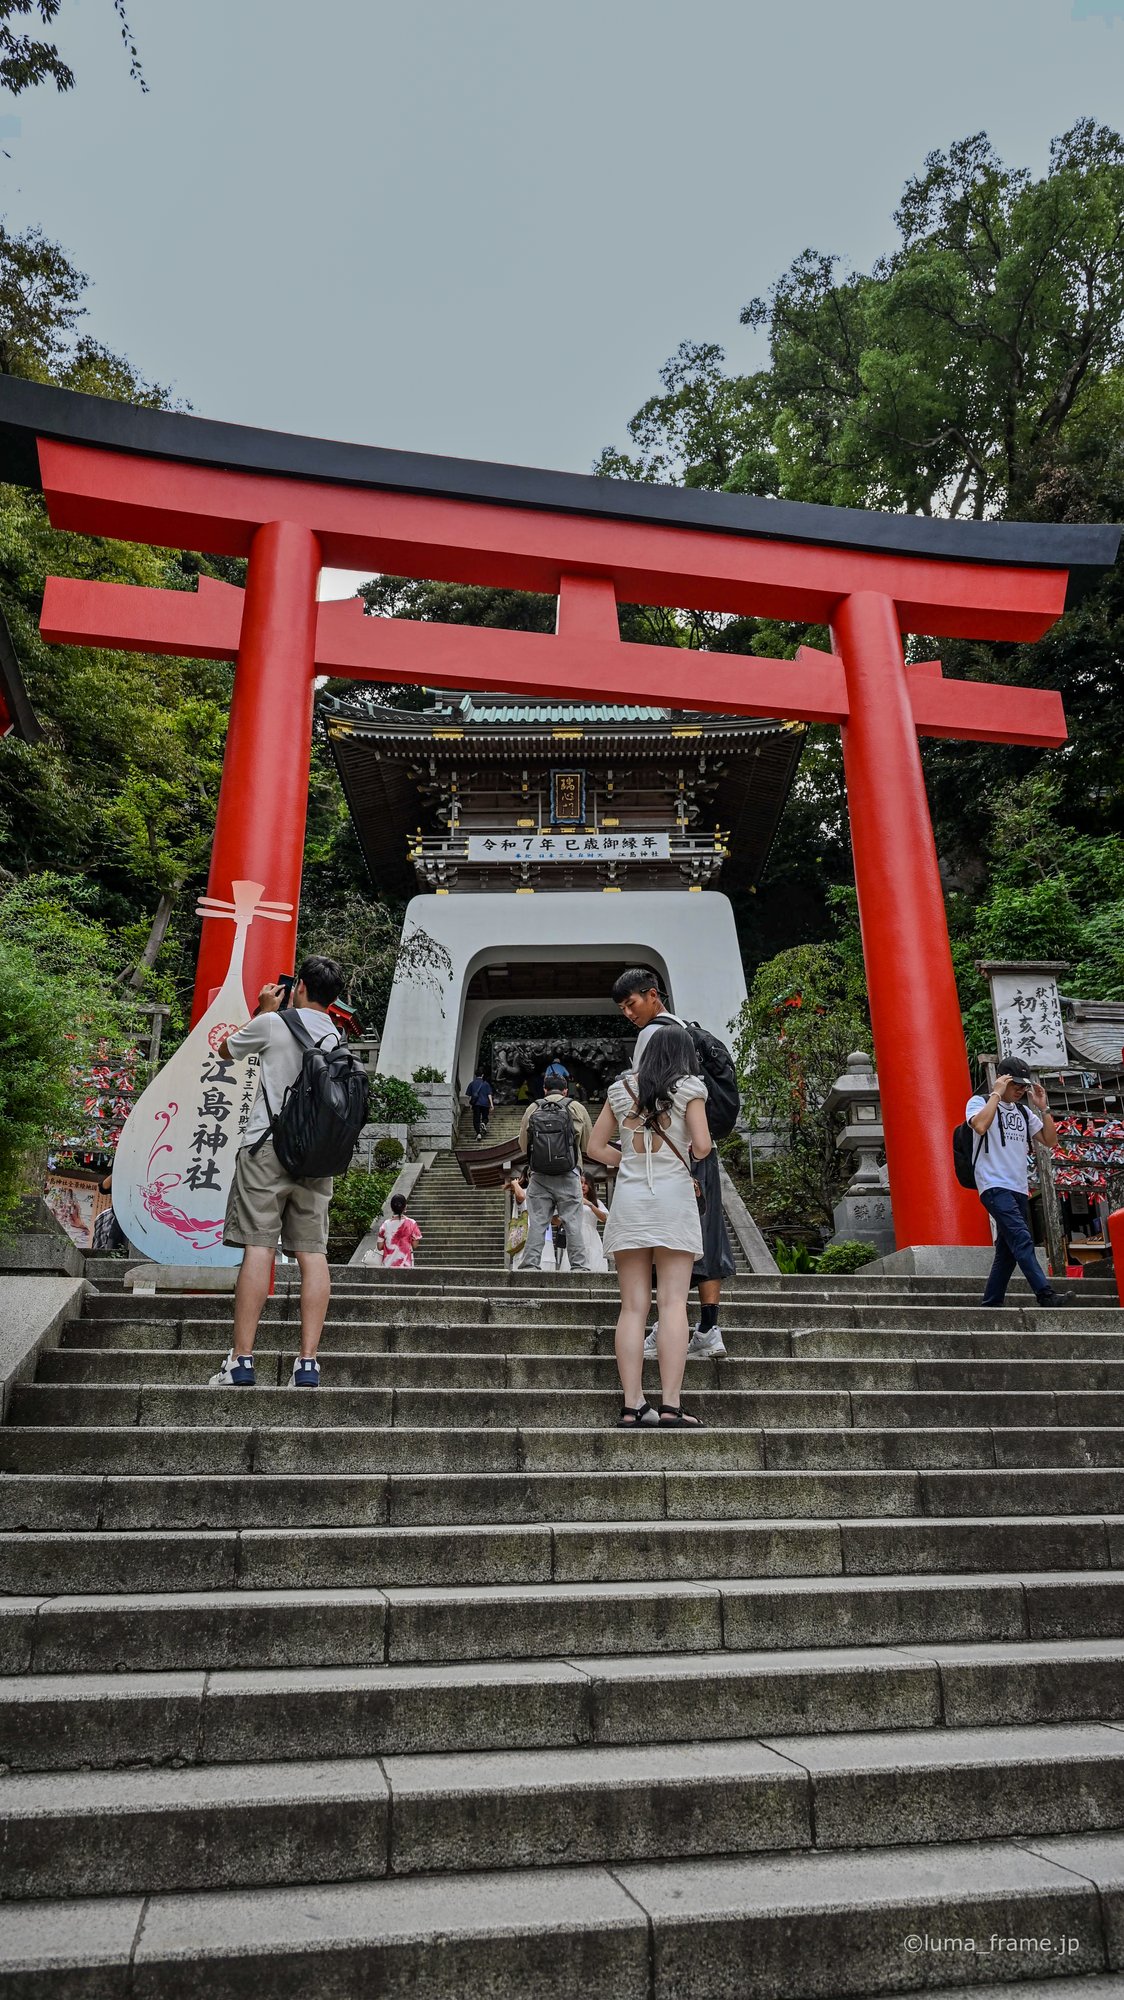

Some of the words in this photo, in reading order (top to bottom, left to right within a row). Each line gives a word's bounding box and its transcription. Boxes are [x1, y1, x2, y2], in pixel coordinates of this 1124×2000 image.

[481, 837, 556, 851] 令和7年
[564, 836, 658, 850] 巳歳御縁年
[1010, 989, 1044, 1057] 初亥祭
[182, 1051, 238, 1192] 江島神社
[237, 1056, 257, 1136] 日本三大弁財天
